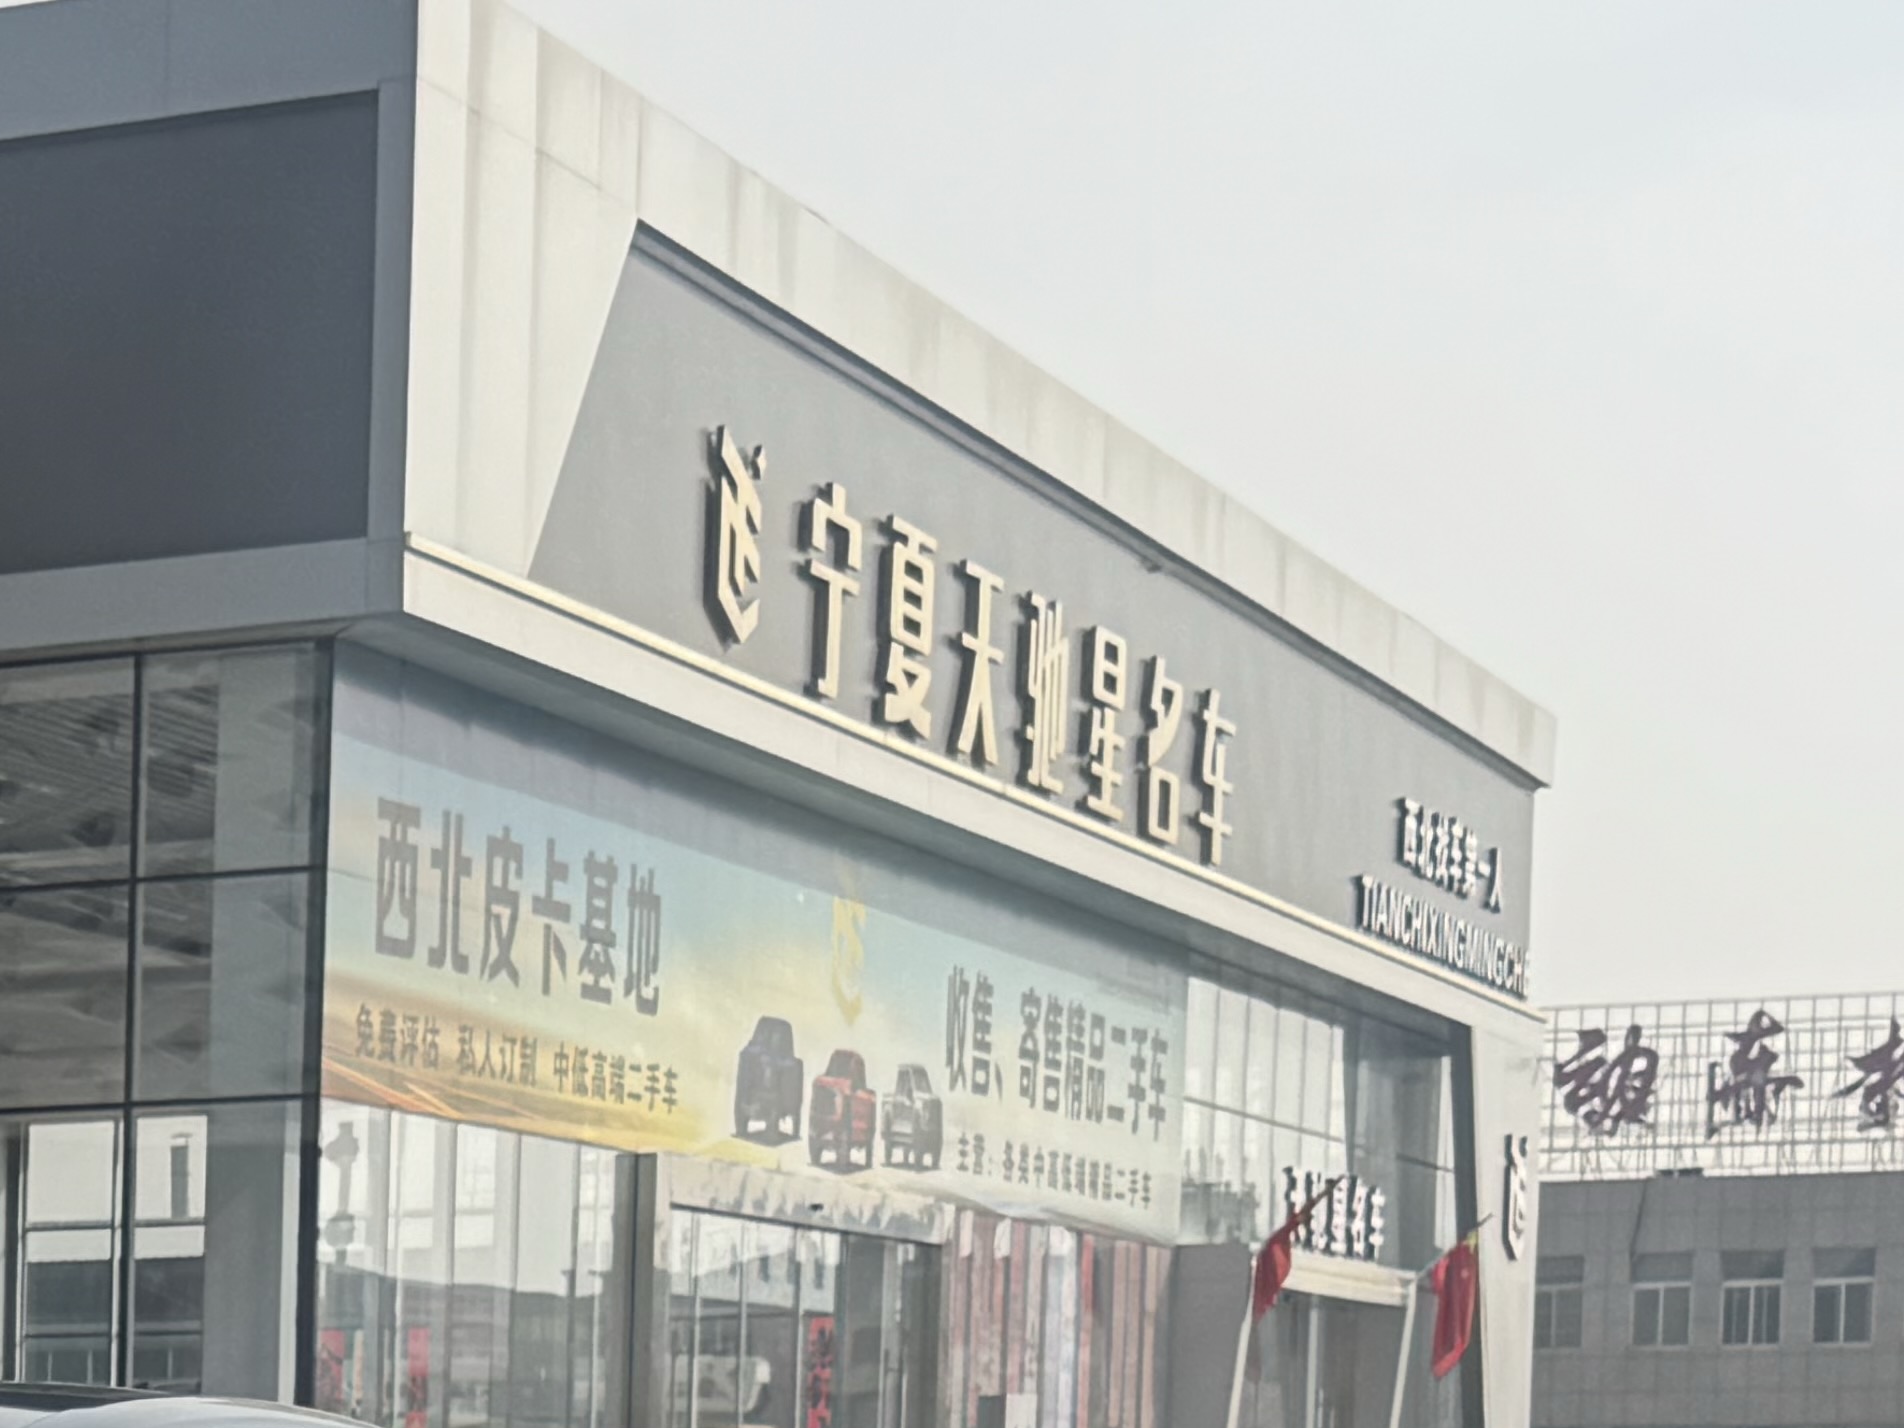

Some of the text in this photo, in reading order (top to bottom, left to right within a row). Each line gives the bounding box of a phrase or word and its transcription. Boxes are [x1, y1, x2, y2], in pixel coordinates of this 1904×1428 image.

[807, 480, 1238, 866] 宁夏天驰星名车
[375, 796, 661, 1017] 西北皮卡基地
[1360, 872, 1530, 998] TIANCHIXINGMINGCH
[355, 1002, 441, 1071] 免费评估
[457, 1023, 538, 1088] 私人订制
